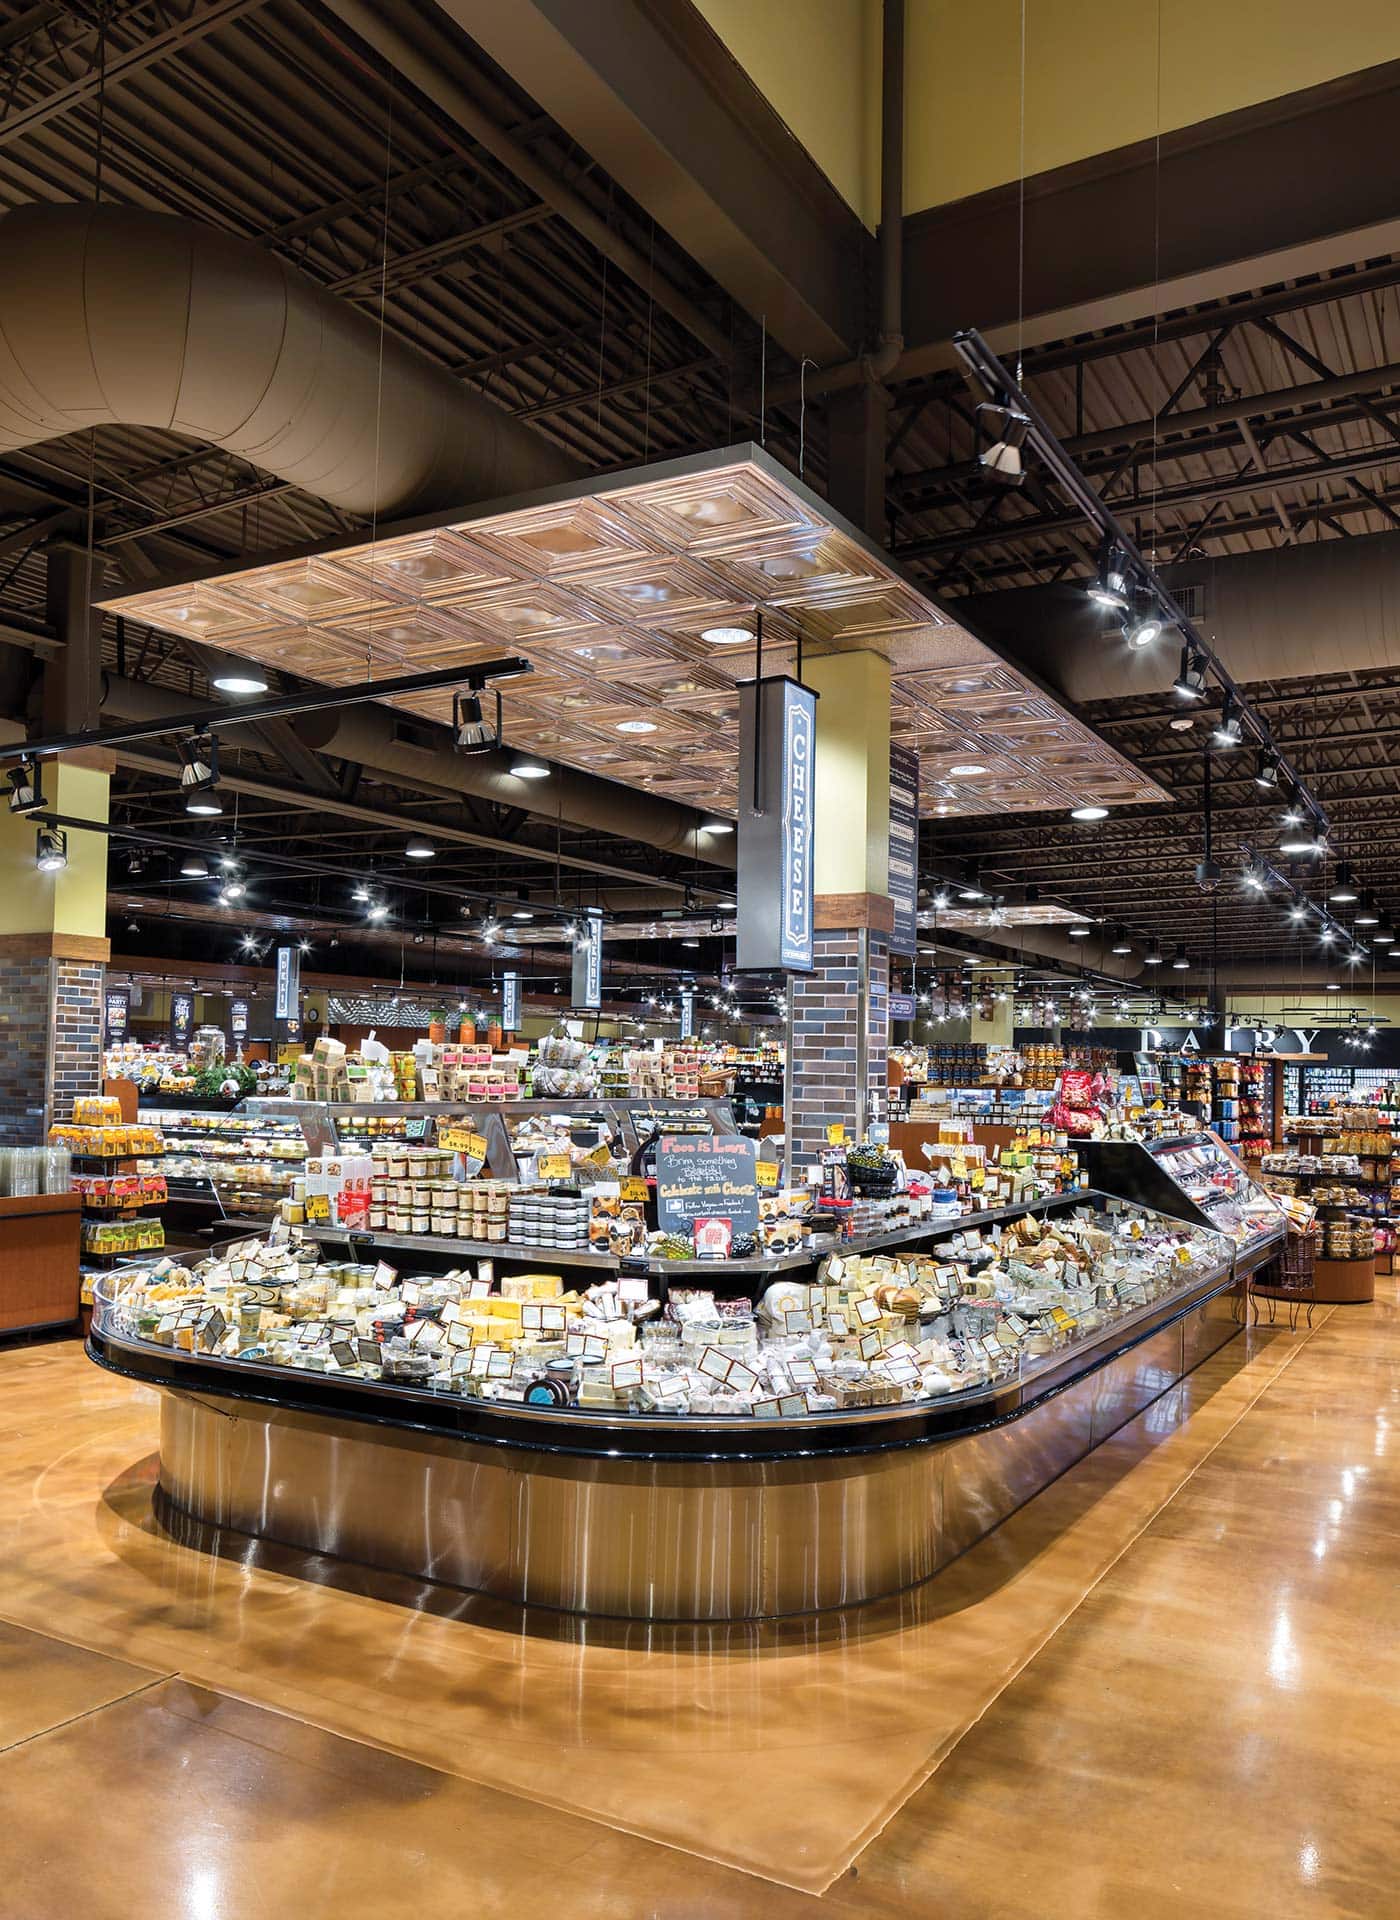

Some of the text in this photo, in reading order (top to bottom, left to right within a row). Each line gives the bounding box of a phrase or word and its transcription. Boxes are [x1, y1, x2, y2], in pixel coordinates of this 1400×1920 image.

[793, 734, 805, 914] CHEESE
[1138, 1029, 1321, 1054] DAIRY
[664, 1154, 738, 1170] Bring something
